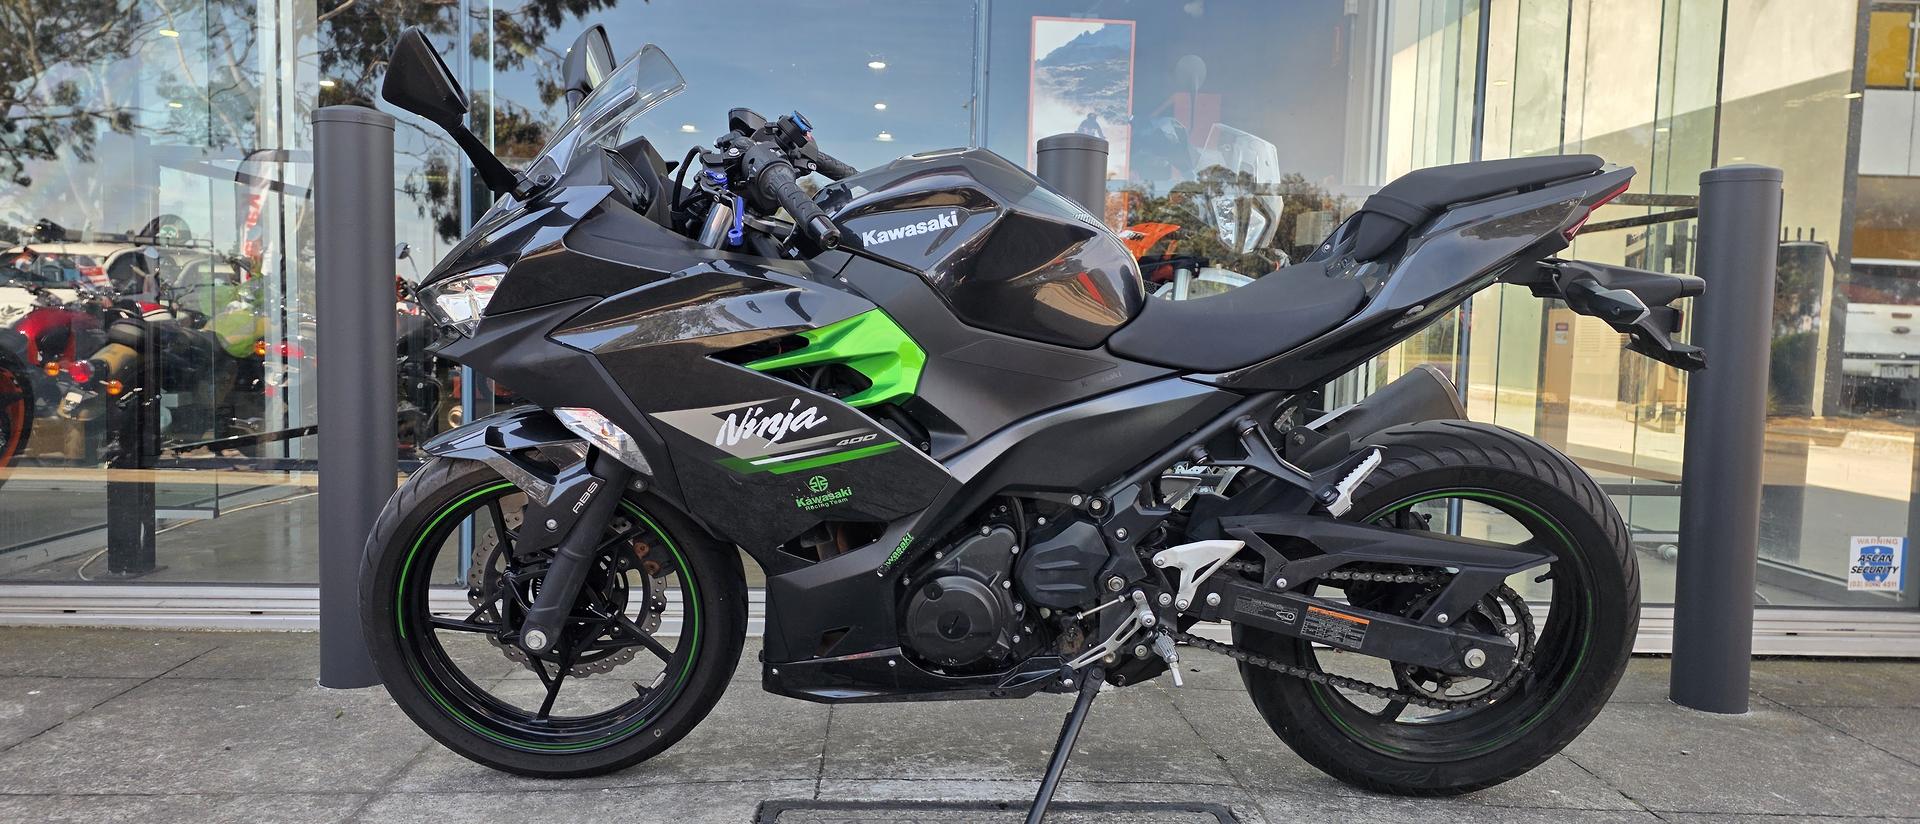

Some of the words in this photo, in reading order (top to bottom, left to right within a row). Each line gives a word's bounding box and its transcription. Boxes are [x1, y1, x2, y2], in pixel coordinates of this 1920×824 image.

[862, 210, 958, 247] Kawasaki
[715, 398, 828, 449] Ninja
[836, 433, 878, 446] 400
[572, 481, 598, 514] ABS
[796, 486, 852, 508] Kawasaki
[804, 502, 830, 511] Racing
[829, 497, 849, 505] Team
[1856, 537, 1898, 545] WARNING
[881, 532, 913, 570] wasaki
[1857, 554, 1895, 562] ASCAN
[1850, 565, 1899, 574] SECURITY
